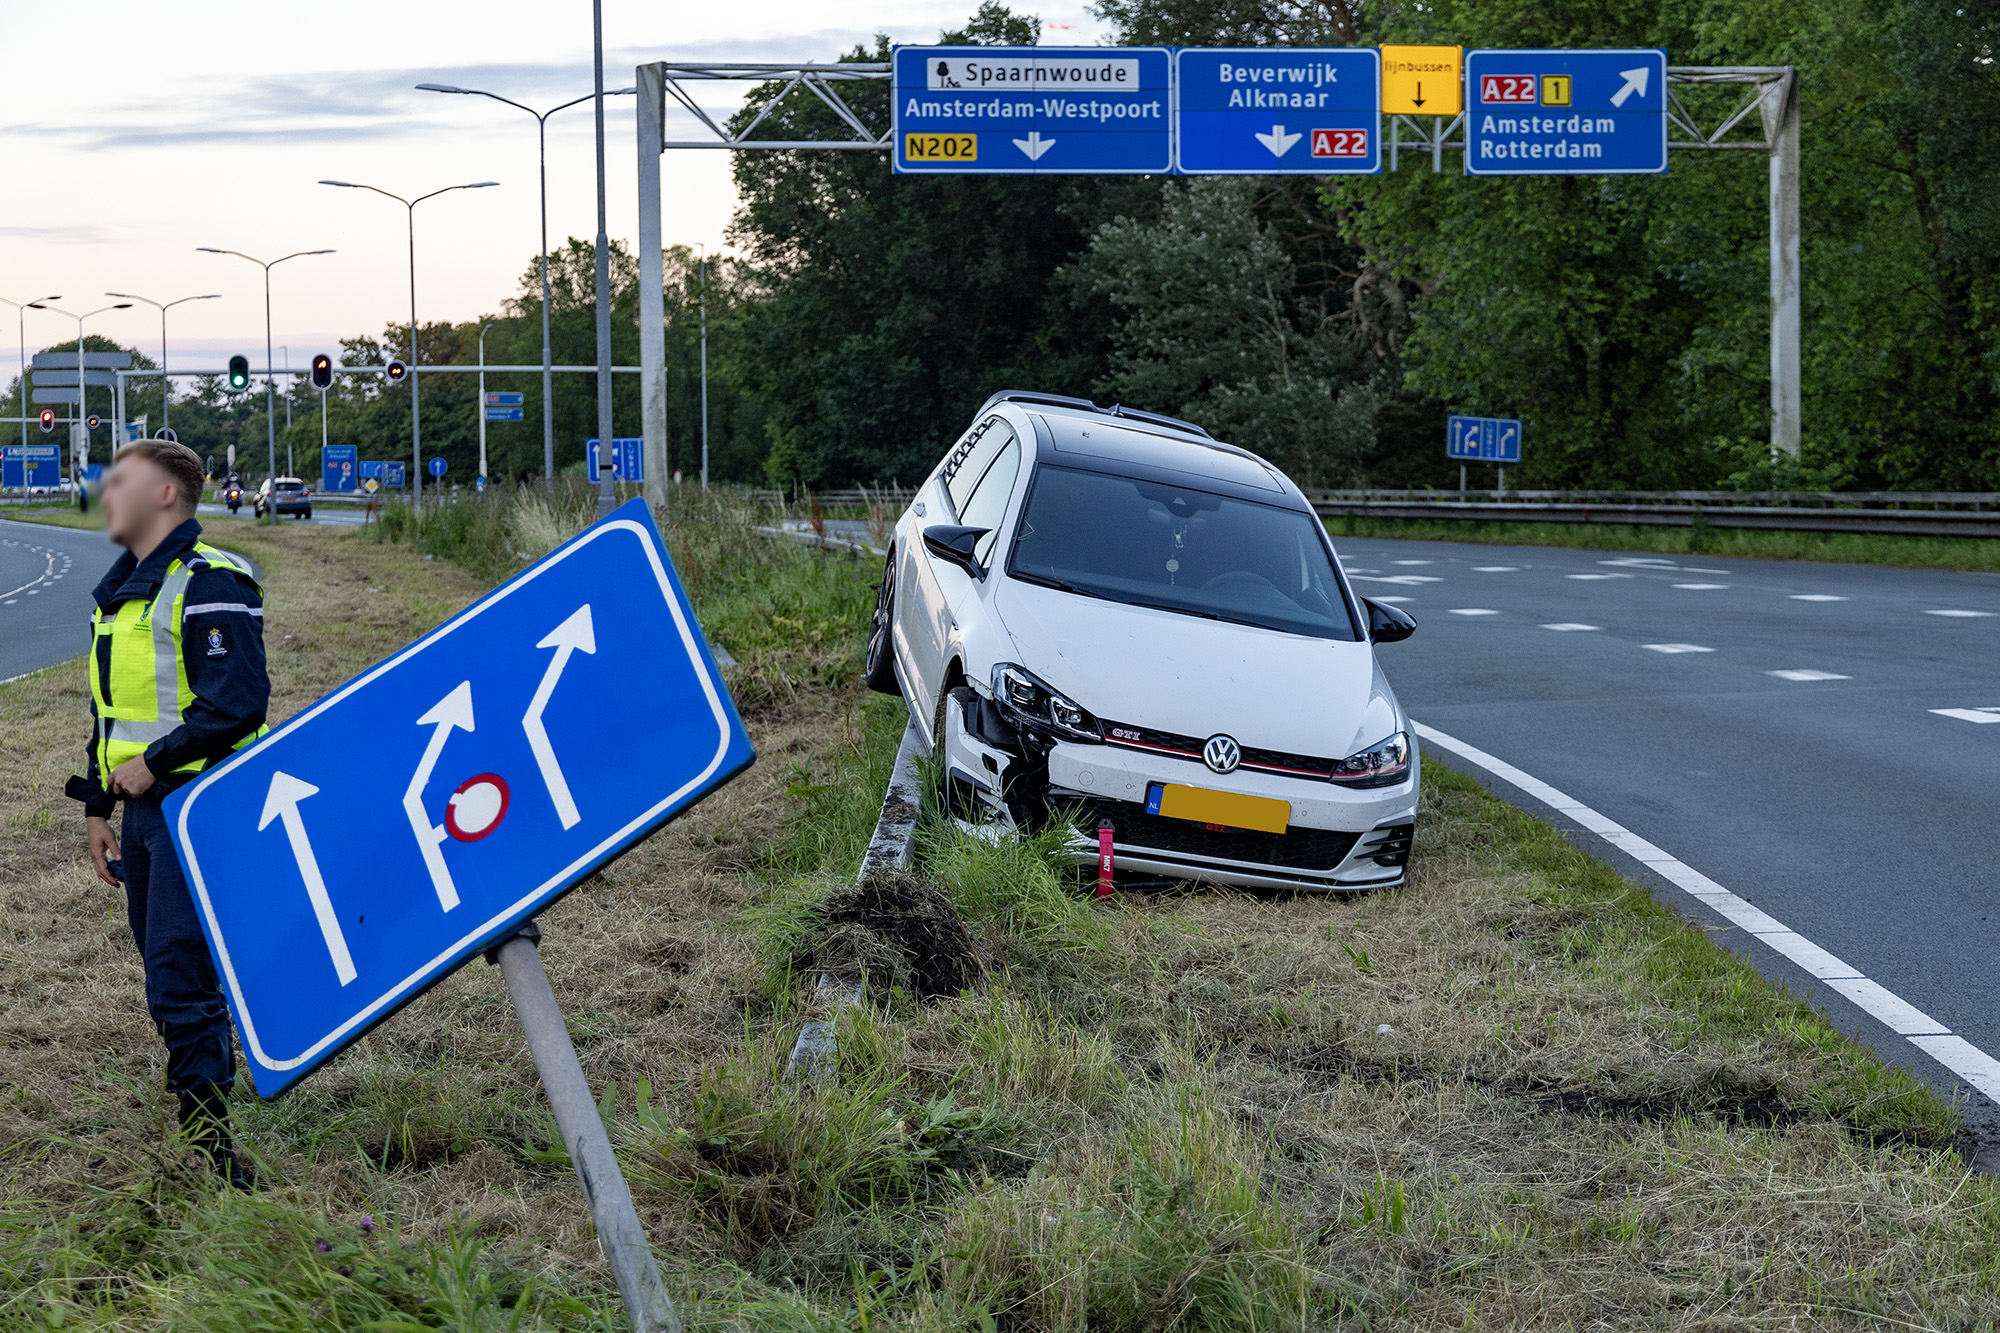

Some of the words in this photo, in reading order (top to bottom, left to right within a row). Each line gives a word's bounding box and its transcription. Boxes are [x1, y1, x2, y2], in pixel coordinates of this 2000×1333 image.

[965, 63, 1127, 86] Spaarnwoude
[1219, 63, 1338, 87] Beverwijk
[1229, 88, 1328, 108] Alkmaar
[1483, 79, 1534, 100] A22
[1553, 80, 1560, 100] 1
[905, 98, 1161, 123] Amsterdam-Westpoort
[1481, 115, 1615, 134] Amsterdam
[908, 138, 975, 158] N202
[1313, 132, 1367, 155] A22
[1481, 140, 1602, 159] Rotterdam
[1112, 728, 1140, 741] GTI
[1149, 802, 1158, 810] NL
[1206, 824, 1225, 833] GTI
